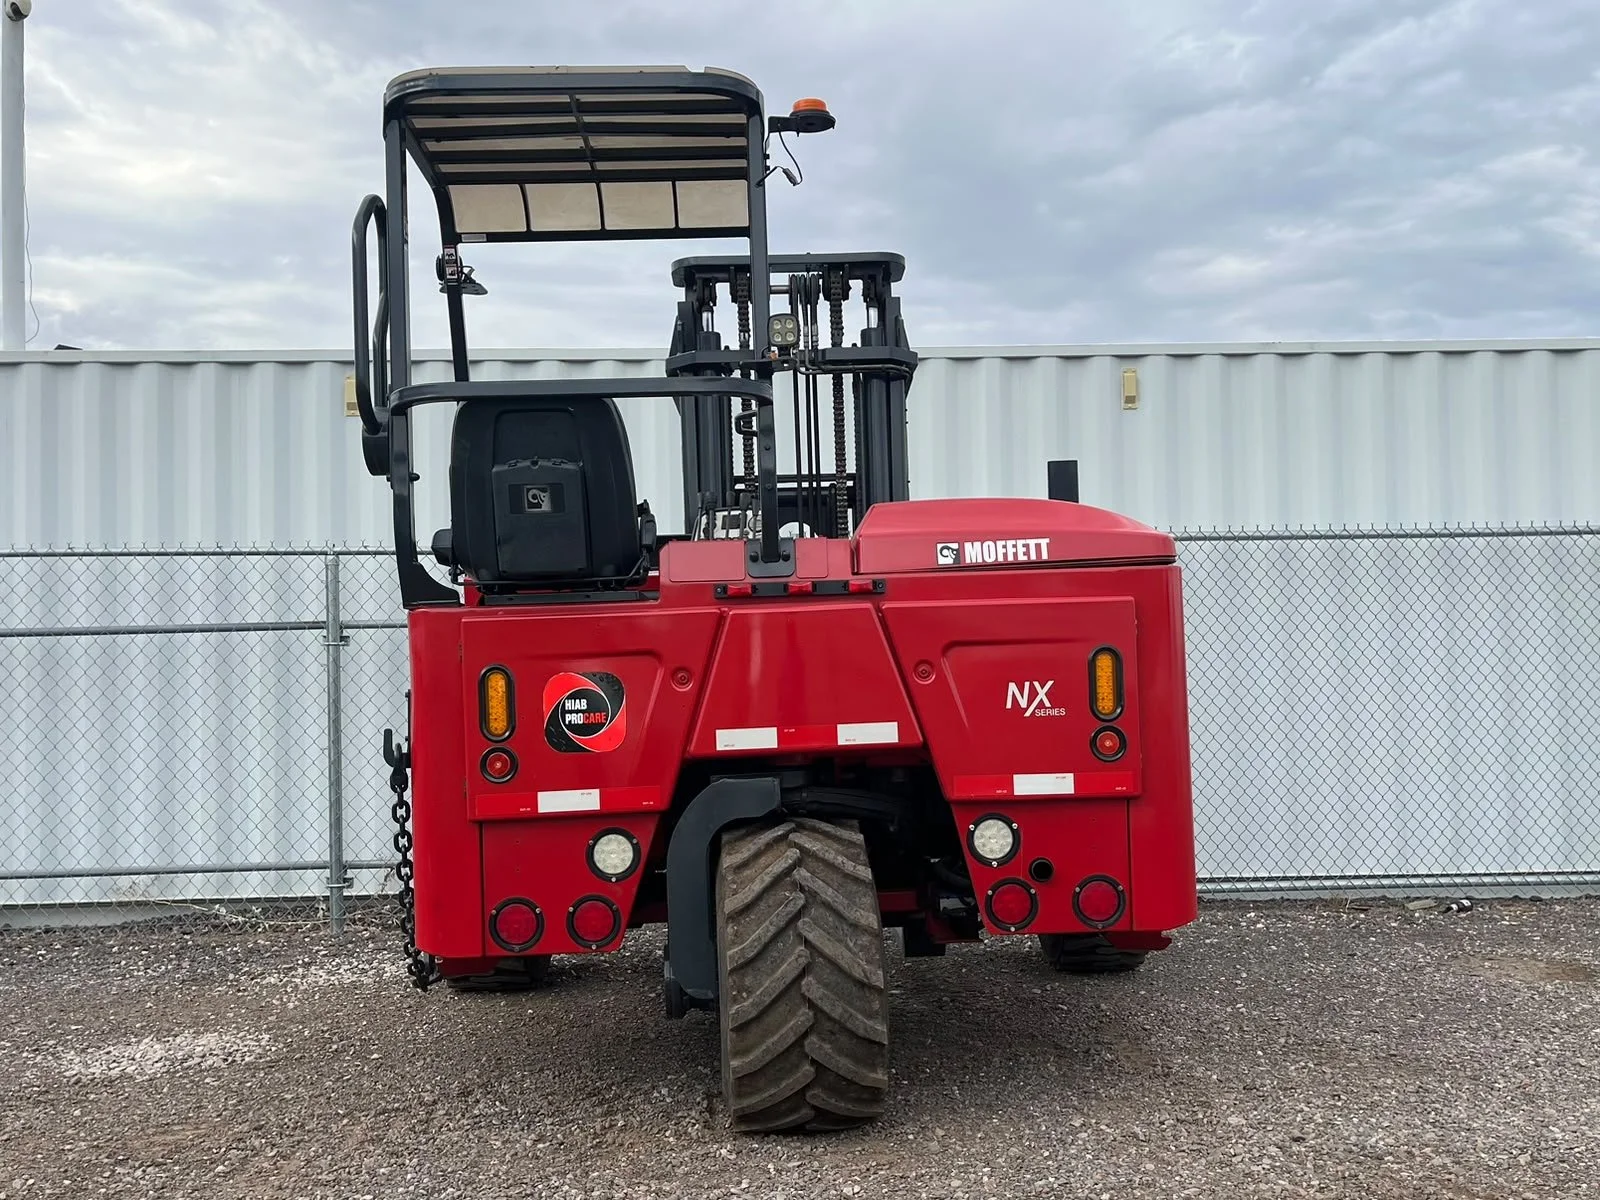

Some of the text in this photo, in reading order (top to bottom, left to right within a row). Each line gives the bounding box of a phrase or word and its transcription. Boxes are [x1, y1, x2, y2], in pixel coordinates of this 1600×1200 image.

[964, 538, 1050, 563] MOFFETT
[565, 699, 587, 710] HIAB
[1005, 680, 1055, 717] NX
[565, 712, 607, 724] PROCARE
[1035, 707, 1066, 717] SERIES
